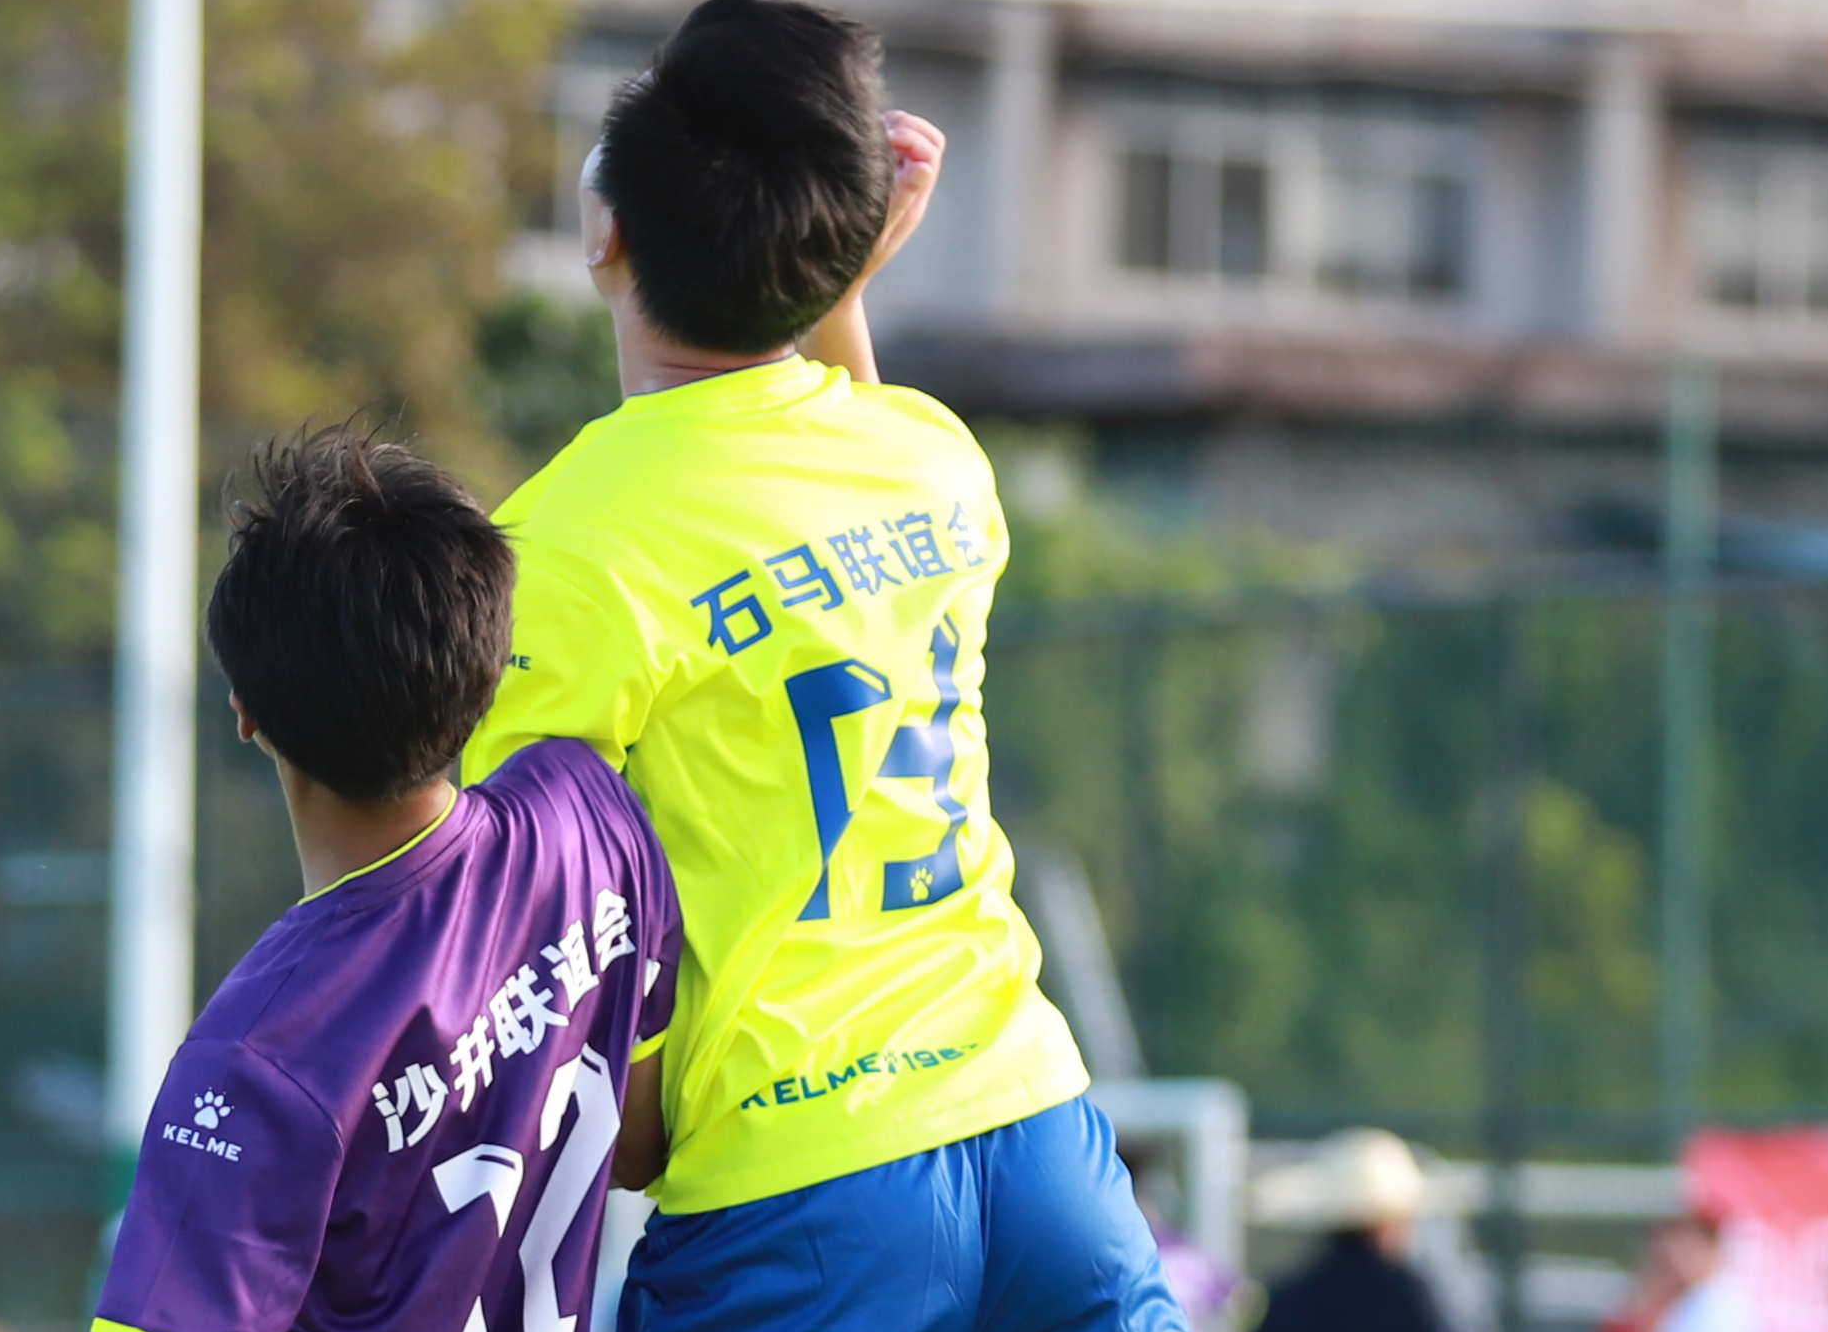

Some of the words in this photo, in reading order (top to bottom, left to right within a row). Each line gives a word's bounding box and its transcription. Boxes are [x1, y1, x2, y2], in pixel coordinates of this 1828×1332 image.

[372, 887, 636, 1153] 沙井联谊会
[163, 1123, 242, 1162] KELME
